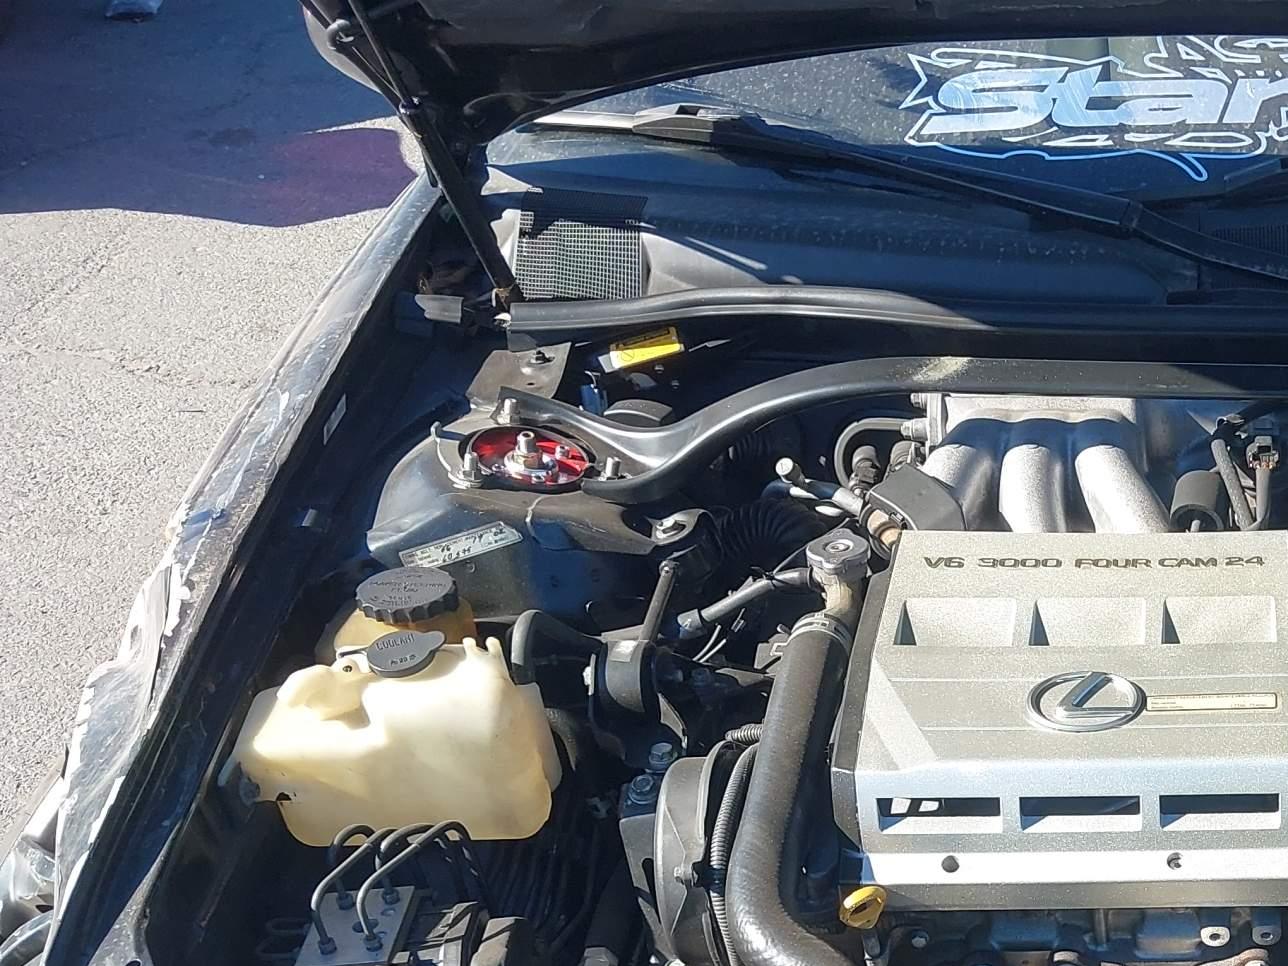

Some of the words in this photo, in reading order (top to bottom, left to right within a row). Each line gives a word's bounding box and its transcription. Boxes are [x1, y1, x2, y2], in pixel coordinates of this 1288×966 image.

[924, 556, 965, 569] V6
[977, 556, 1063, 569] 3000
[1074, 557, 1153, 569] FOUR
[1158, 556, 1218, 568] CAM
[1225, 555, 1265, 567] 24
